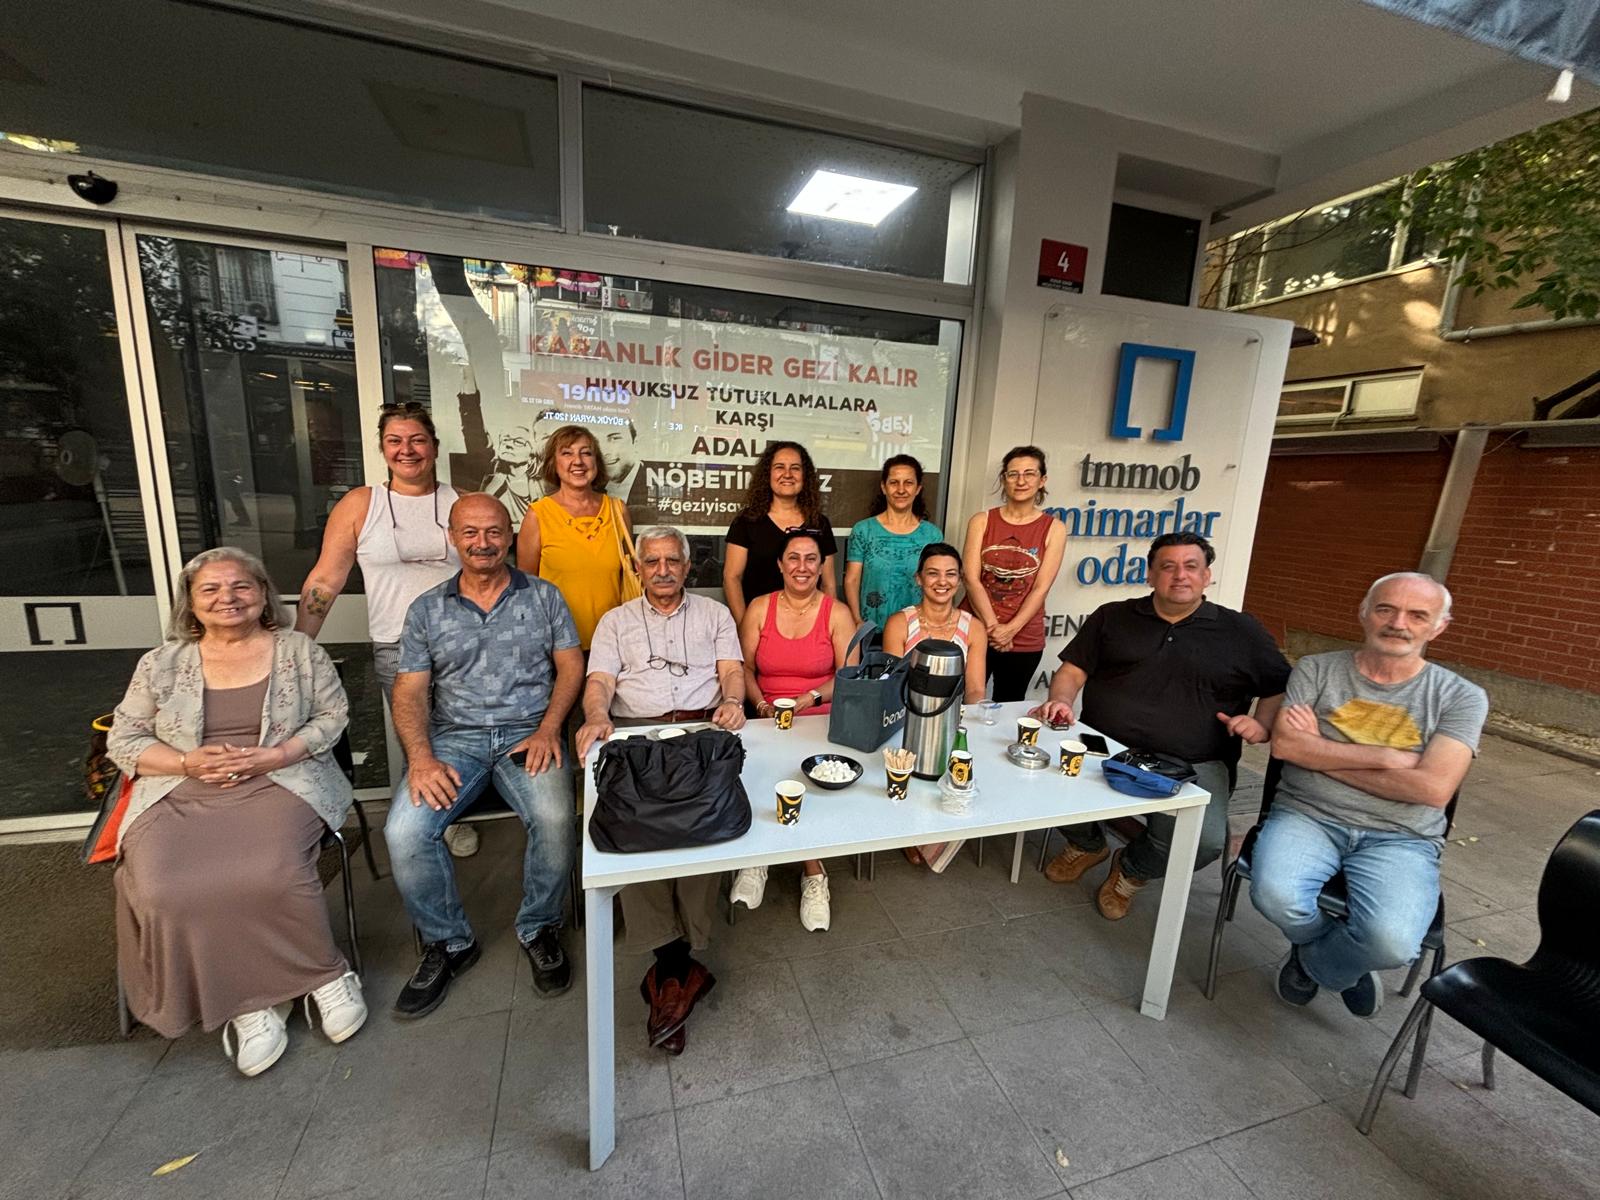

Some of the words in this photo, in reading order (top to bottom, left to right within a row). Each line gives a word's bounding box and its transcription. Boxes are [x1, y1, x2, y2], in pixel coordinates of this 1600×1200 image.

[1057, 251, 1070, 272] 4
[529, 334, 682, 368] KARANLIK
[692, 343, 773, 376] GİDER
[783, 356, 839, 382] GEZİ
[848, 363, 918, 388] KALIR
[585, 376, 700, 402] HUKUKSUZ
[706, 385, 878, 413] TUTUKLAMALARA
[715, 410, 774, 431] KARŞI
[691, 436, 776, 458] ADAL
[1080, 453, 1200, 491] tmmob
[1043, 497, 1221, 538] mimarlar
[1077, 543, 1148, 586] oda
